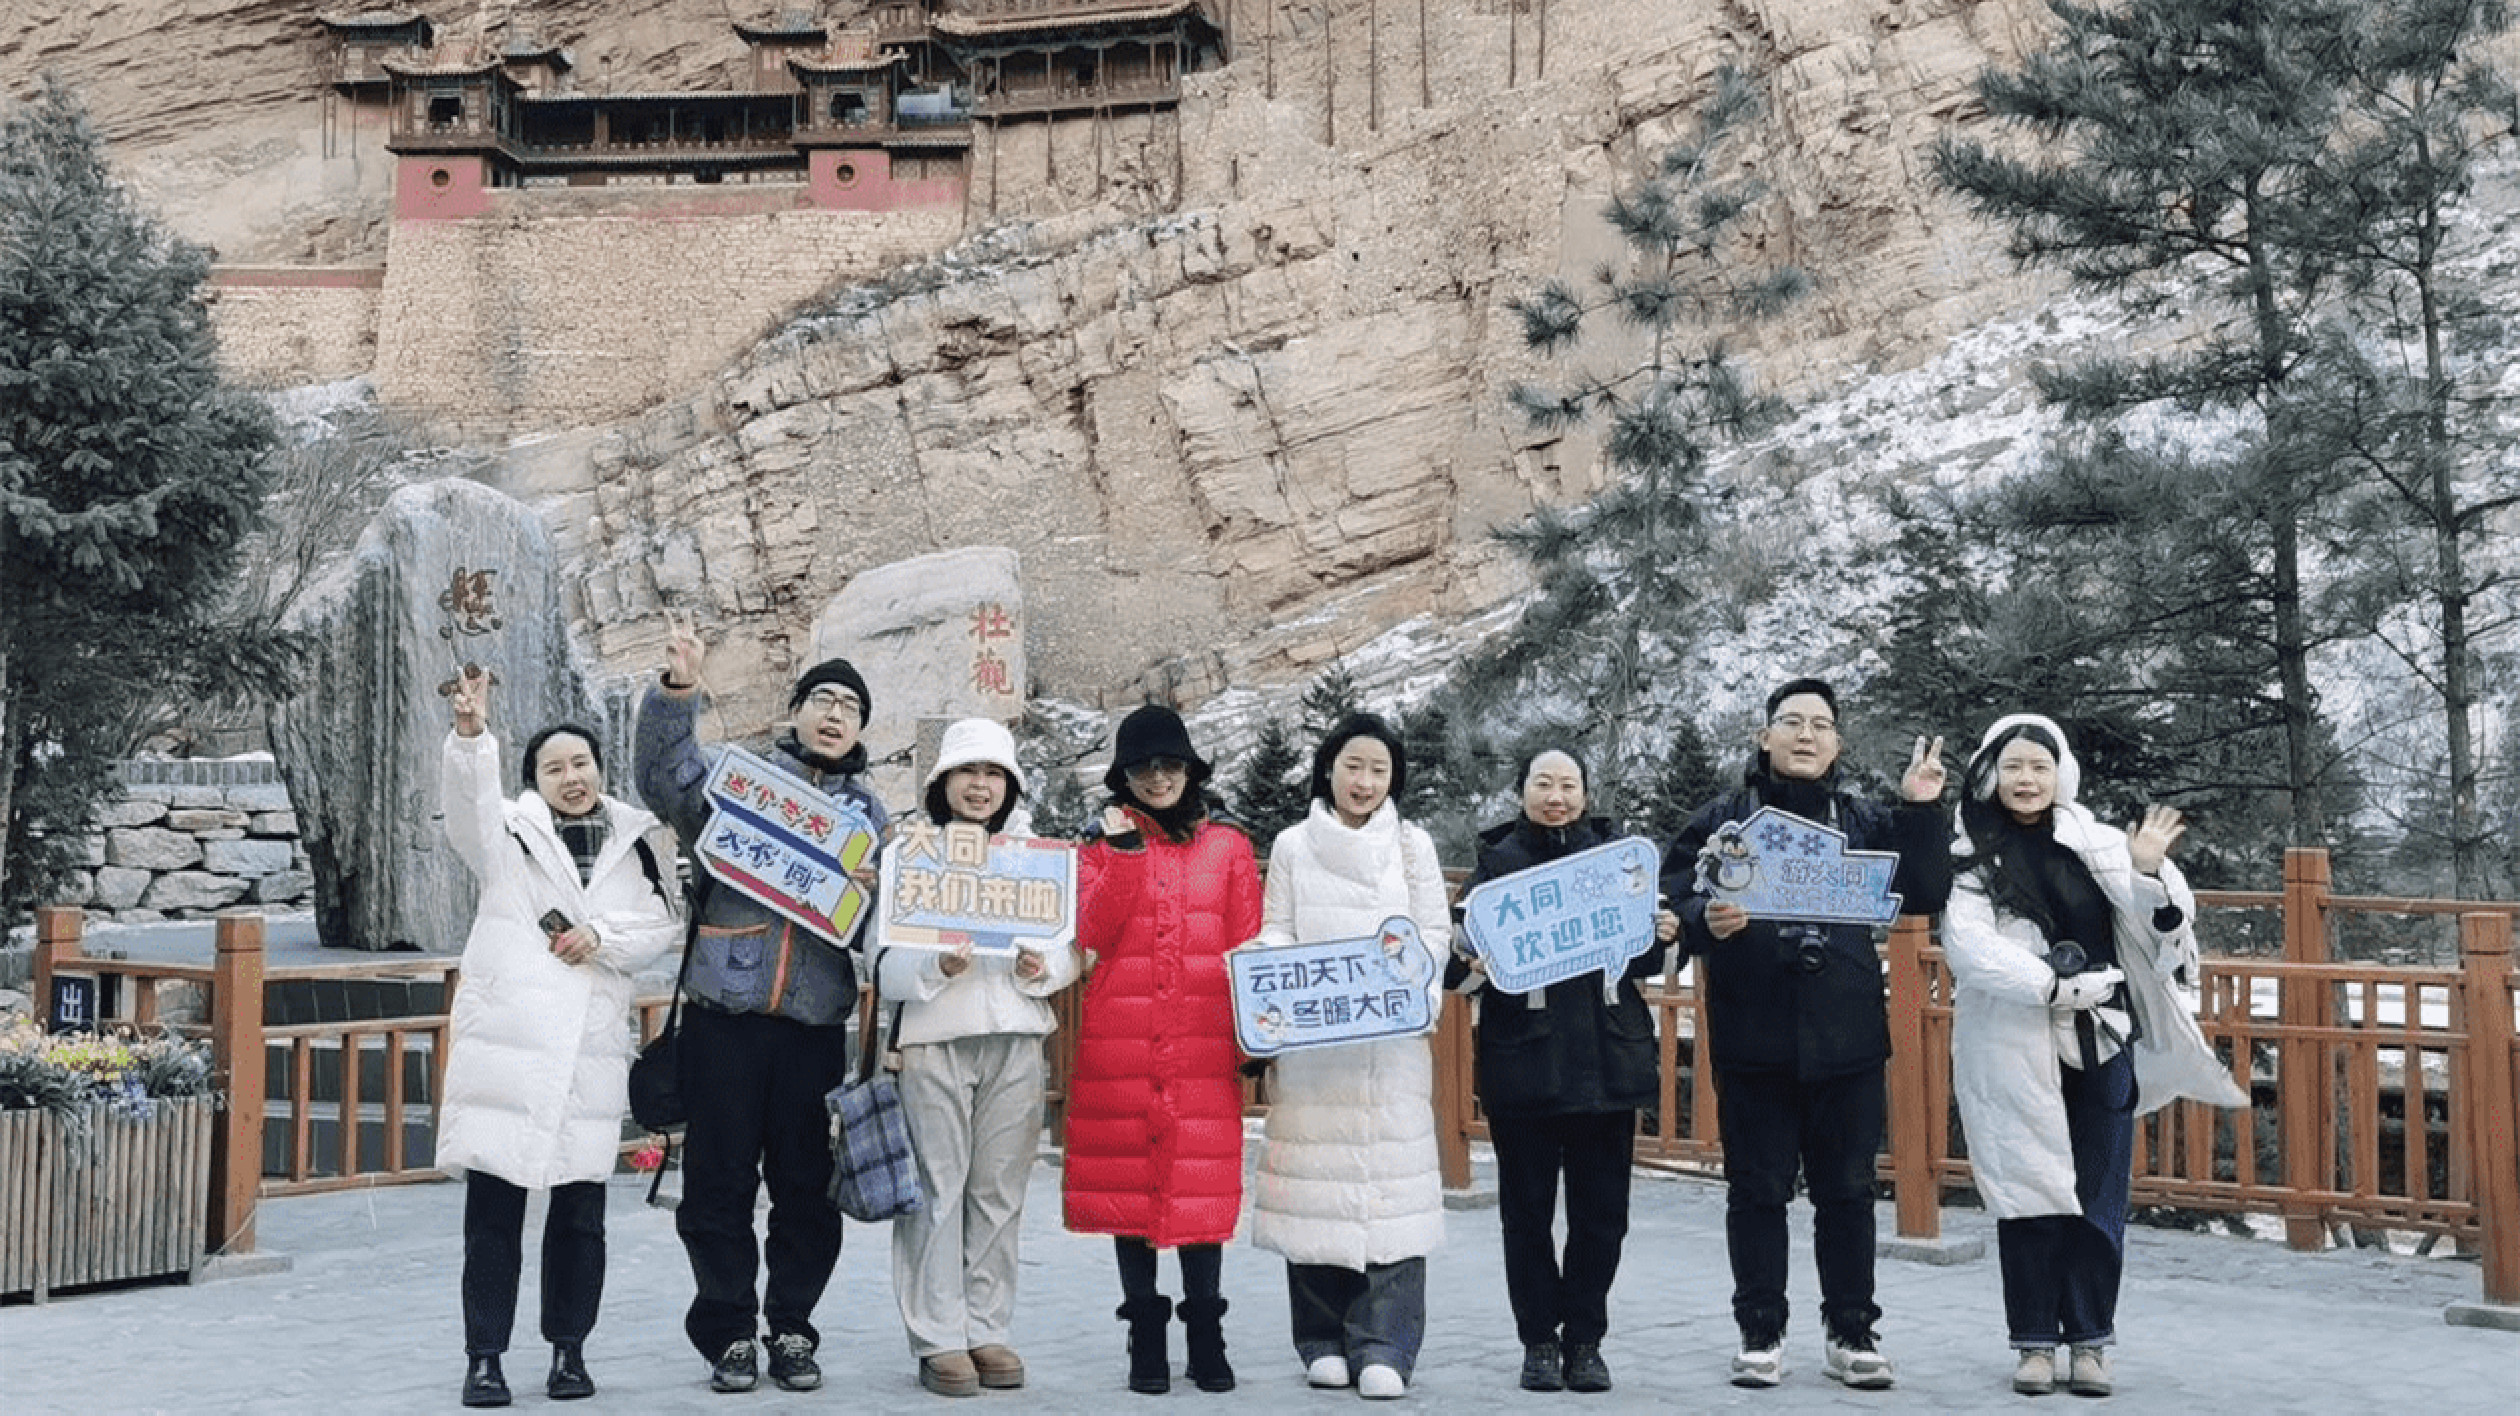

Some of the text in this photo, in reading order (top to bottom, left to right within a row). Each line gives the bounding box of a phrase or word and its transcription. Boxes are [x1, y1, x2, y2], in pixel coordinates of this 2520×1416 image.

[722, 771, 835, 843] 这个冬天
[899, 820, 989, 867] 大同
[898, 869, 1061, 920] 我们来啦
[1494, 878, 1563, 928] 大同
[1512, 906, 1625, 967] 欢迎您
[1250, 953, 1366, 993] 云动天下
[61, 982, 83, 1025] 出
[1292, 988, 1411, 1028] 冬暖大同
